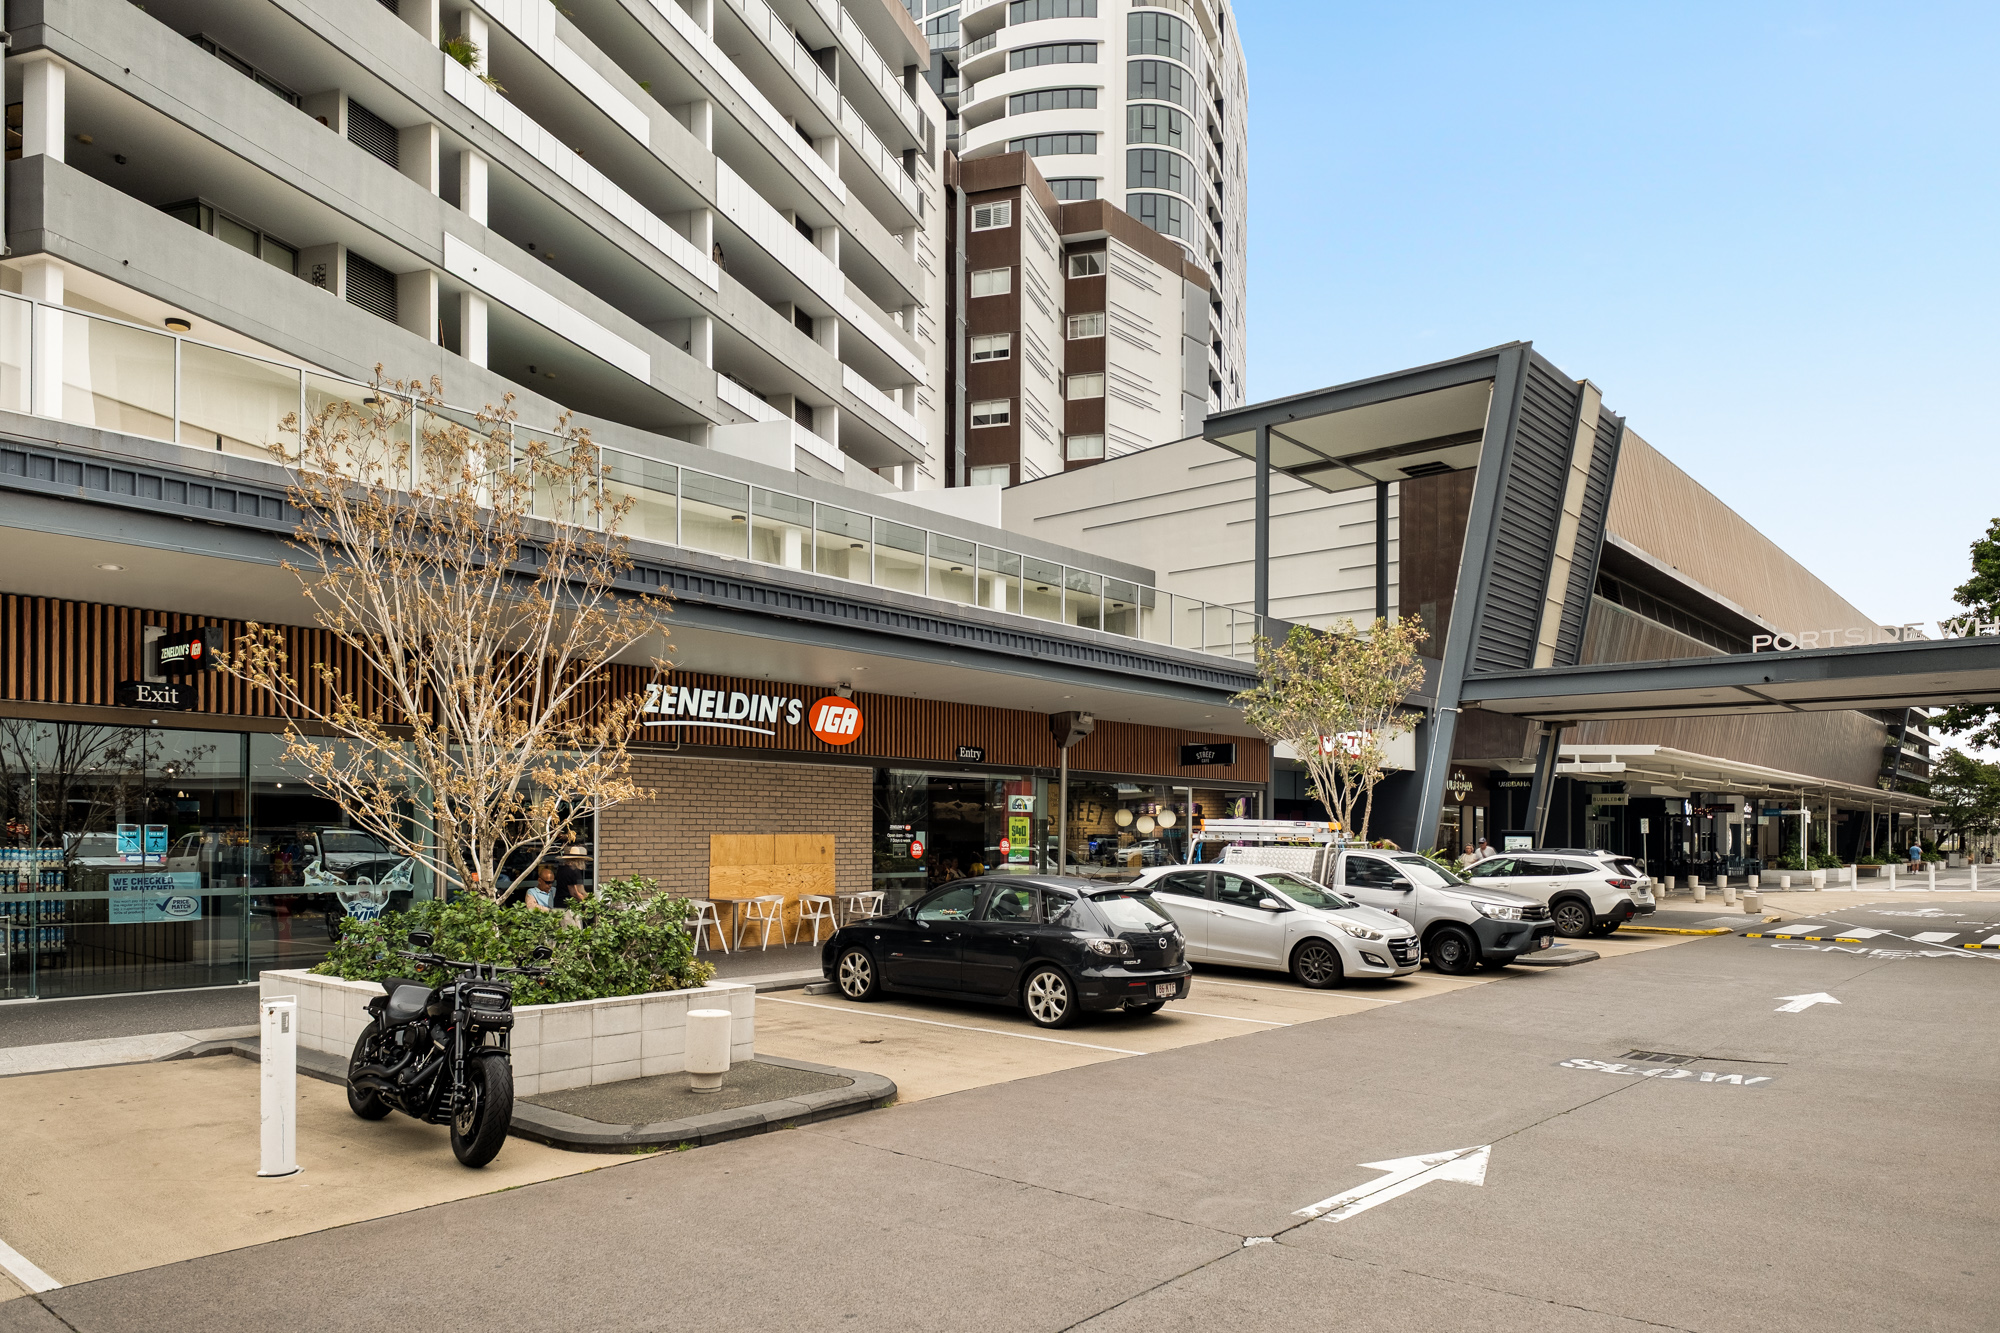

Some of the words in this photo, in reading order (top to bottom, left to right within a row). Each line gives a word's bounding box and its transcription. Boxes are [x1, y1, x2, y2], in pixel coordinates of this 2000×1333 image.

[1752, 622, 1924, 653] PORTSIDE
[161, 643, 190, 660] ZENELDIN'S
[191, 642, 202, 656] IGA
[136, 684, 179, 703] Exit
[643, 683, 803, 725] ZENELDIN'S
[815, 704, 858, 735] IGA
[960, 746, 981, 761] Entry
[1196, 751, 1215, 759] STREET
[131, 877, 173, 885] CHECKED
[349, 911, 379, 920] WIN
[1560, 1058, 1772, 1085] SLOW
